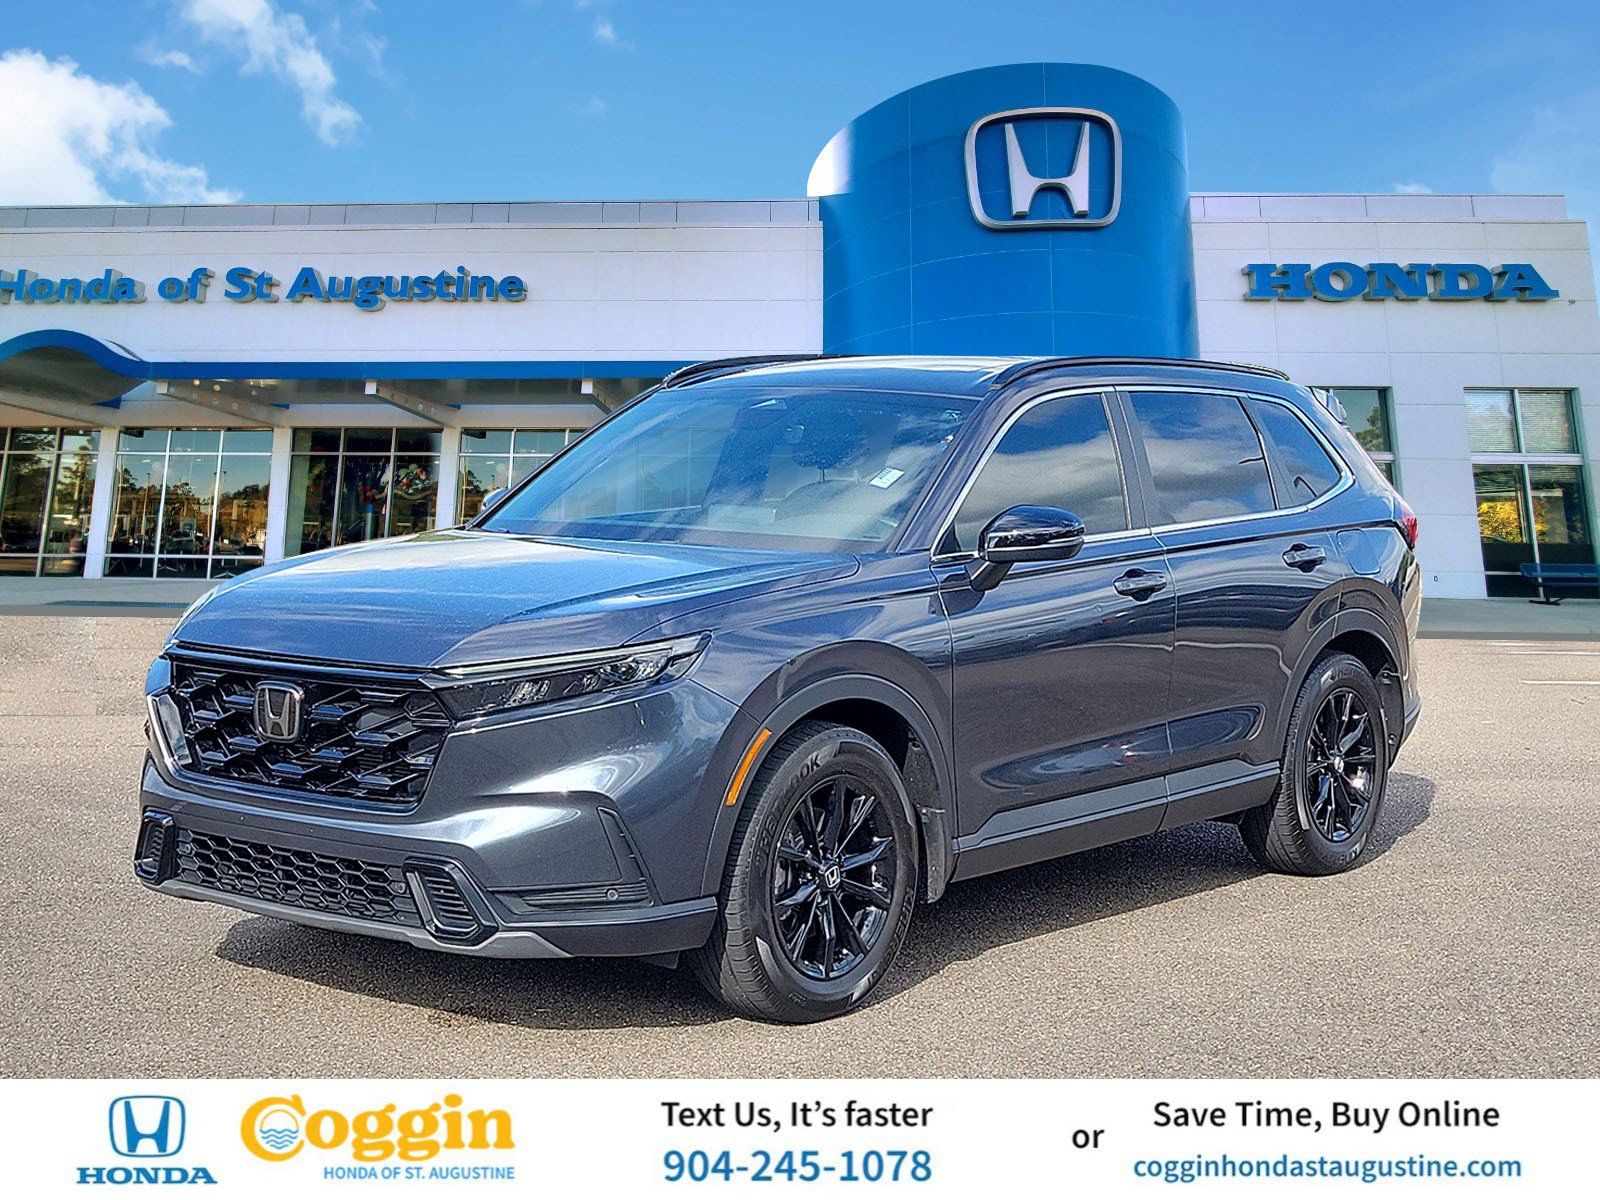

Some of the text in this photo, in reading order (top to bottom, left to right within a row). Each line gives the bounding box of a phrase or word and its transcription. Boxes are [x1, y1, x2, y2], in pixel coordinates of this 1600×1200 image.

[0, 265, 526, 311] Honda of St Augustine
[1244, 262, 1560, 301] HONDA
